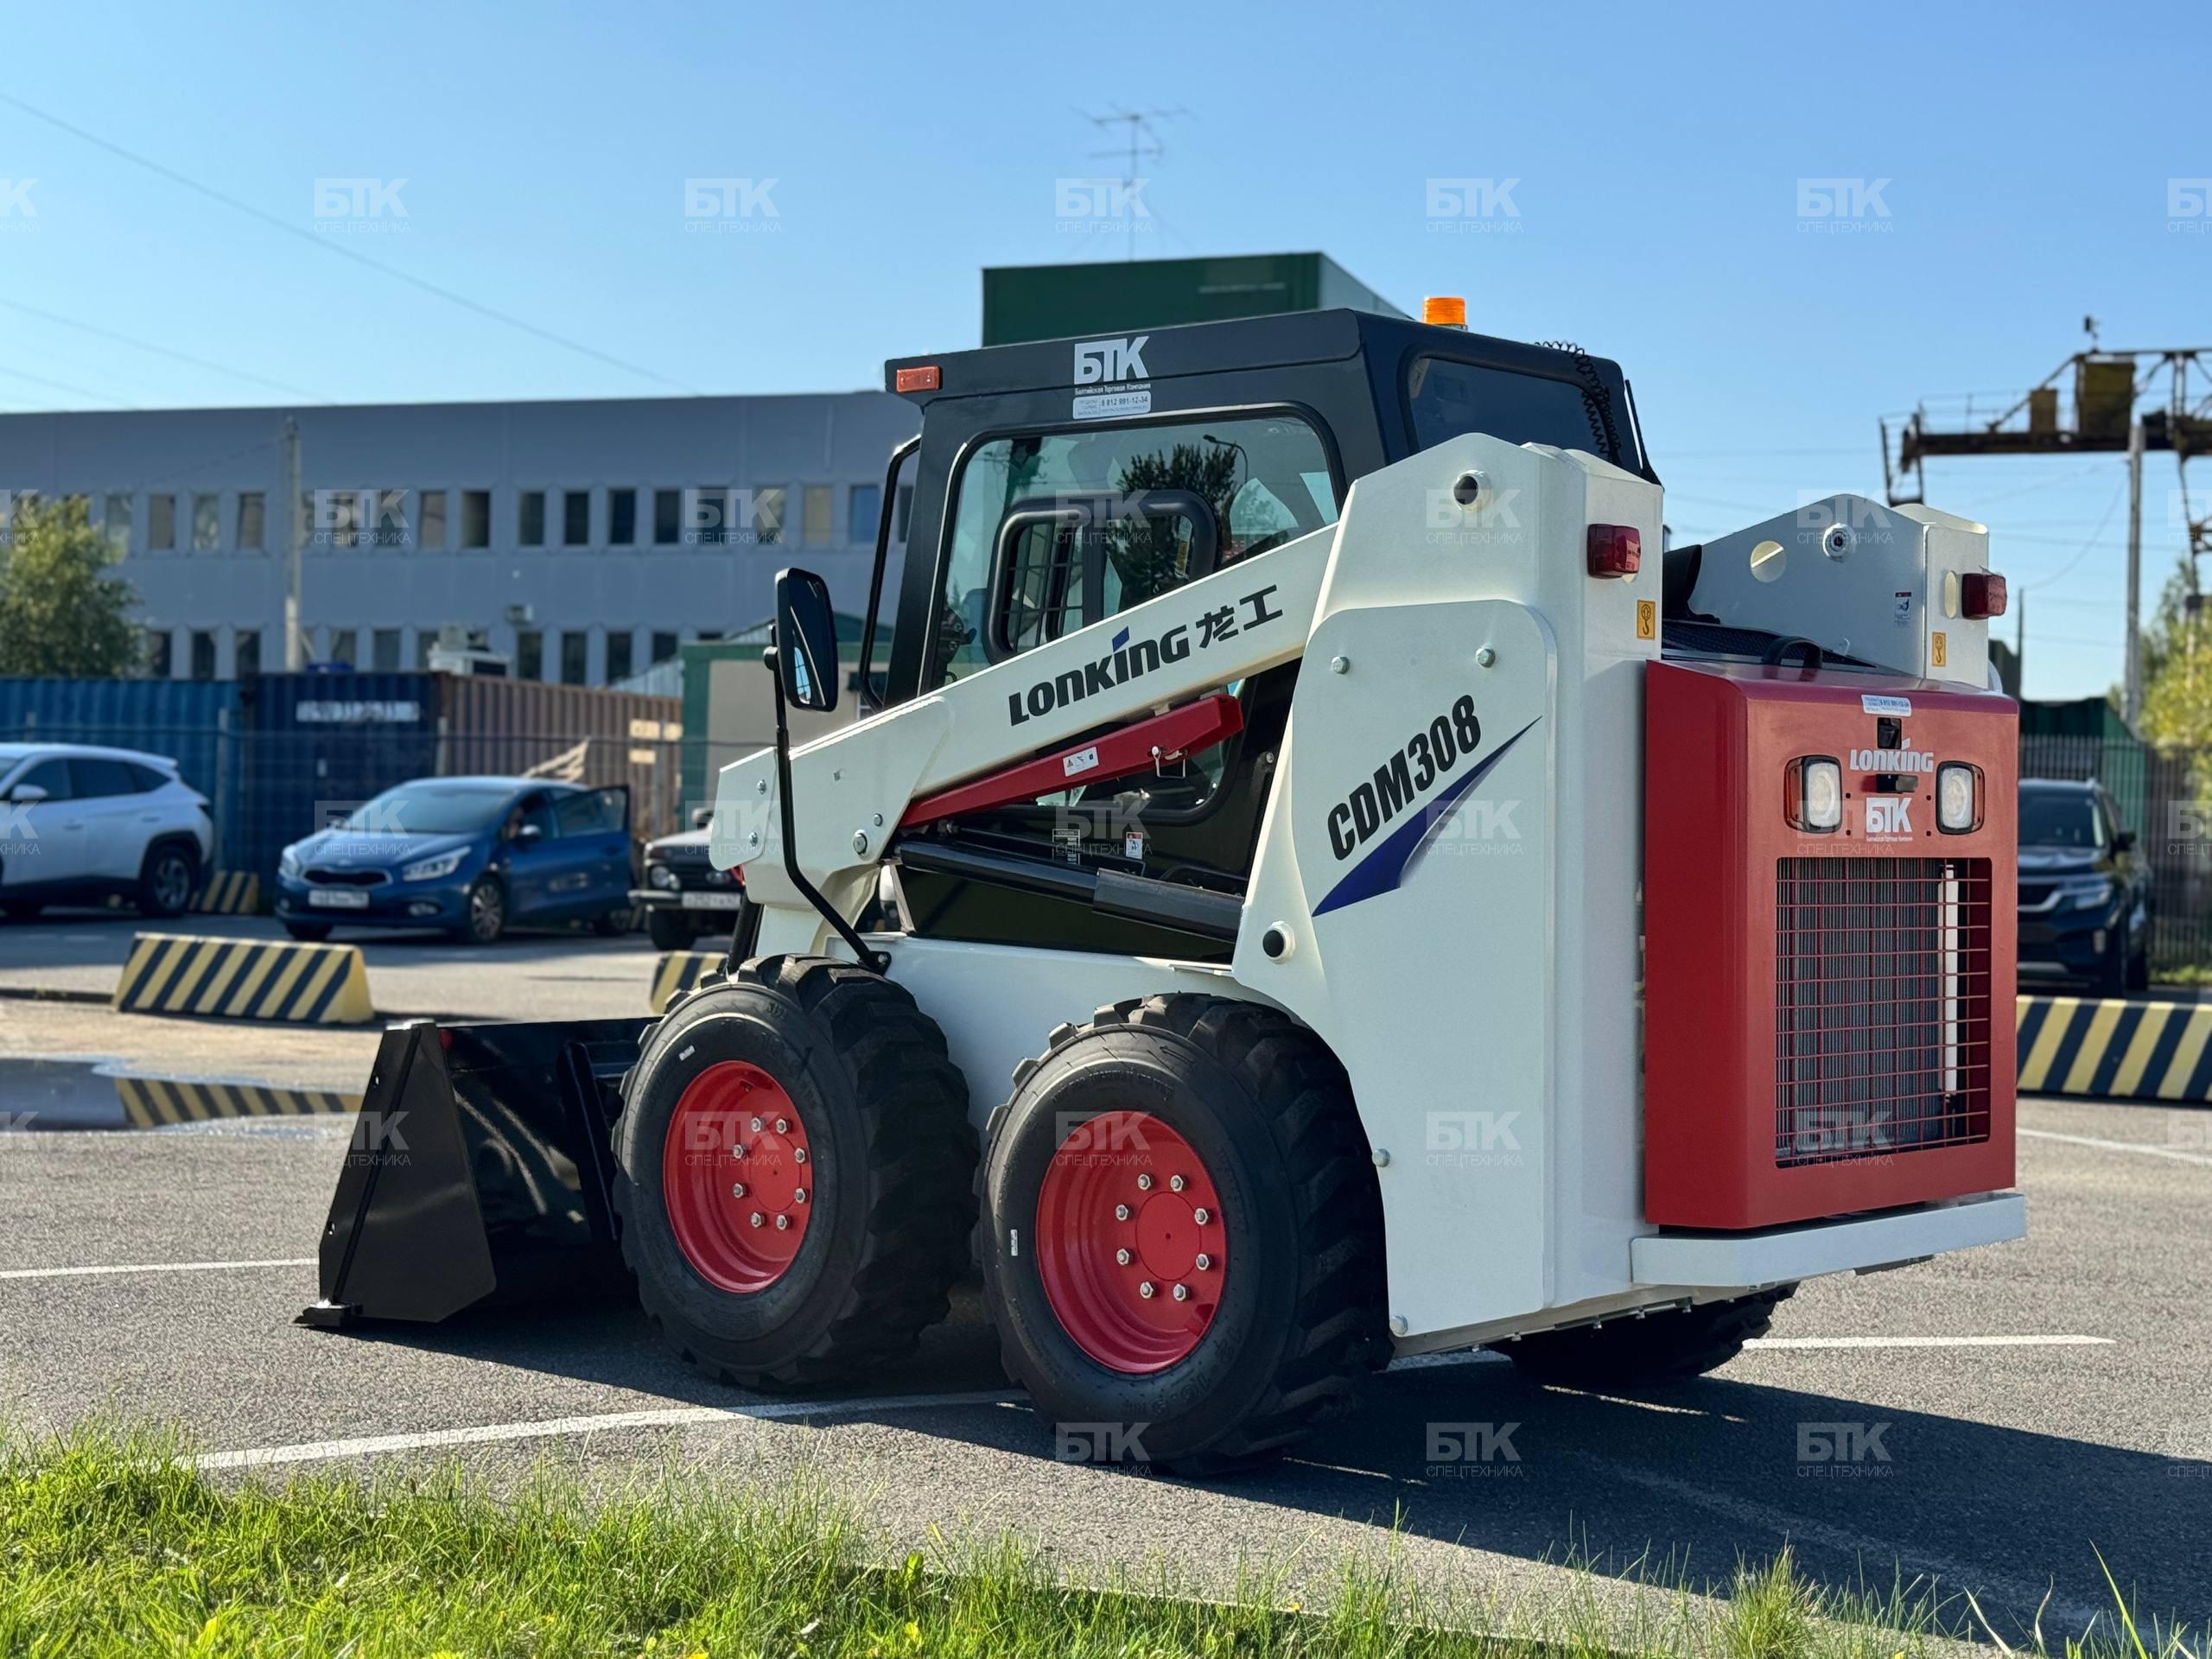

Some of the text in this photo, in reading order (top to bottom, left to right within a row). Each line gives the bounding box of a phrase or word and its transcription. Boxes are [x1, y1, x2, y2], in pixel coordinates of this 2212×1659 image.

[1074, 335, 1150, 385] БТК
[1007, 625, 1191, 727] LONKING
[1327, 694, 1481, 861] CDM308
[1849, 736, 1935, 773] LONKING
[1866, 797, 1912, 834] БТК
